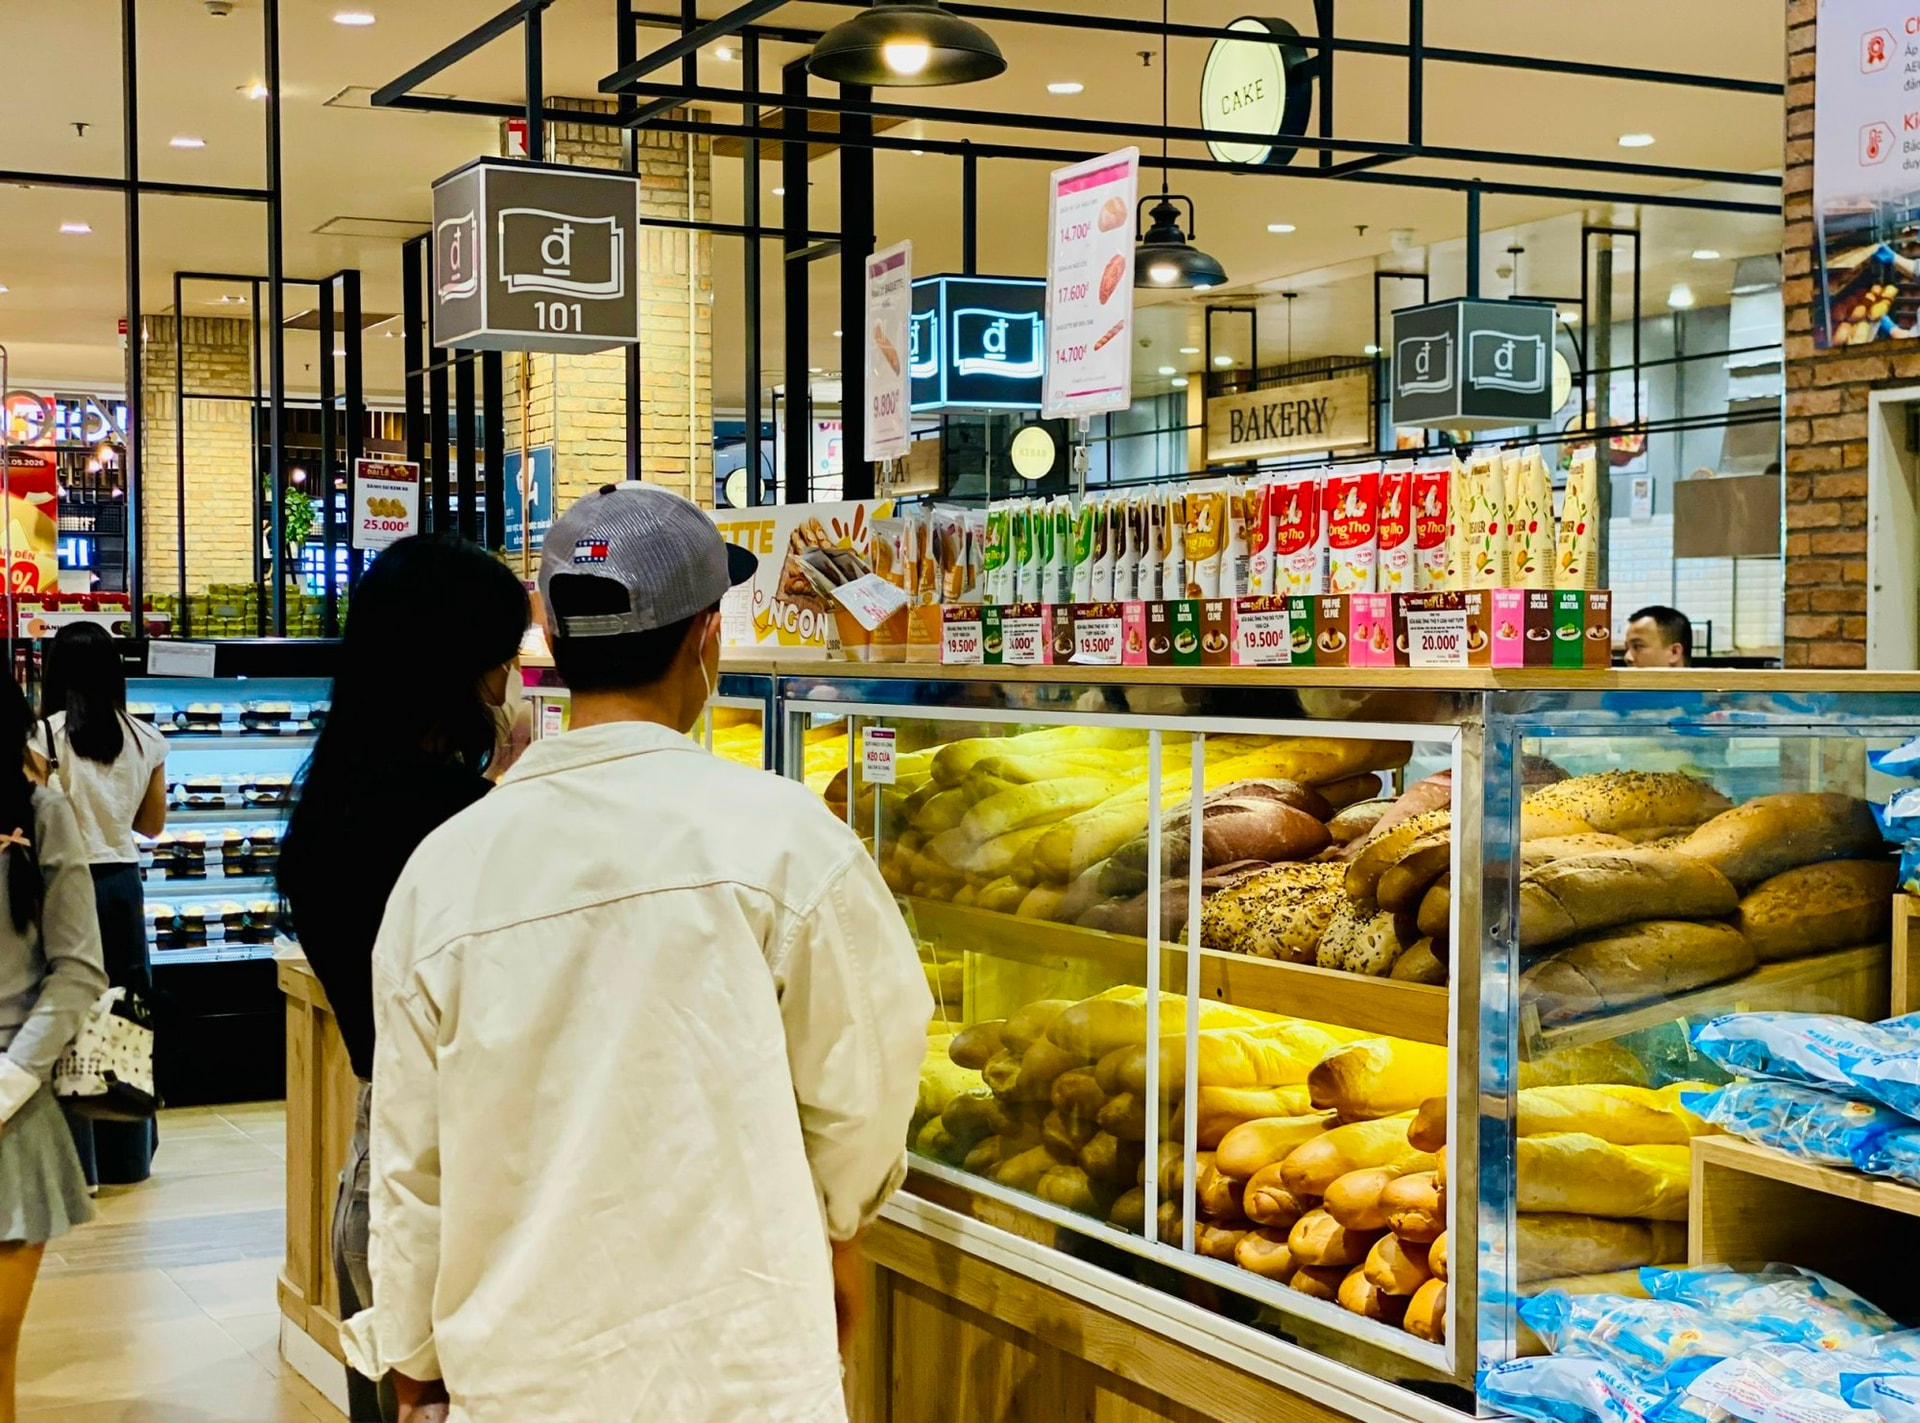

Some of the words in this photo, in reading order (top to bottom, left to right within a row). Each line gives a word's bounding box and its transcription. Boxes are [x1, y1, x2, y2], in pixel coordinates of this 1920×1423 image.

[1221, 79, 1264, 115] CAKE
[1904, 112, 1920, 131] Ki
[534, 301, 582, 332] 101
[1229, 397, 1328, 444] BAKERY
[363, 519, 409, 531] 25.000đ
[947, 638, 977, 653] 19.500đ
[1080, 636, 1114, 653] 19.500đ
[1244, 629, 1284, 648] 19.500đ
[1422, 634, 1459, 650] 20.000đ
